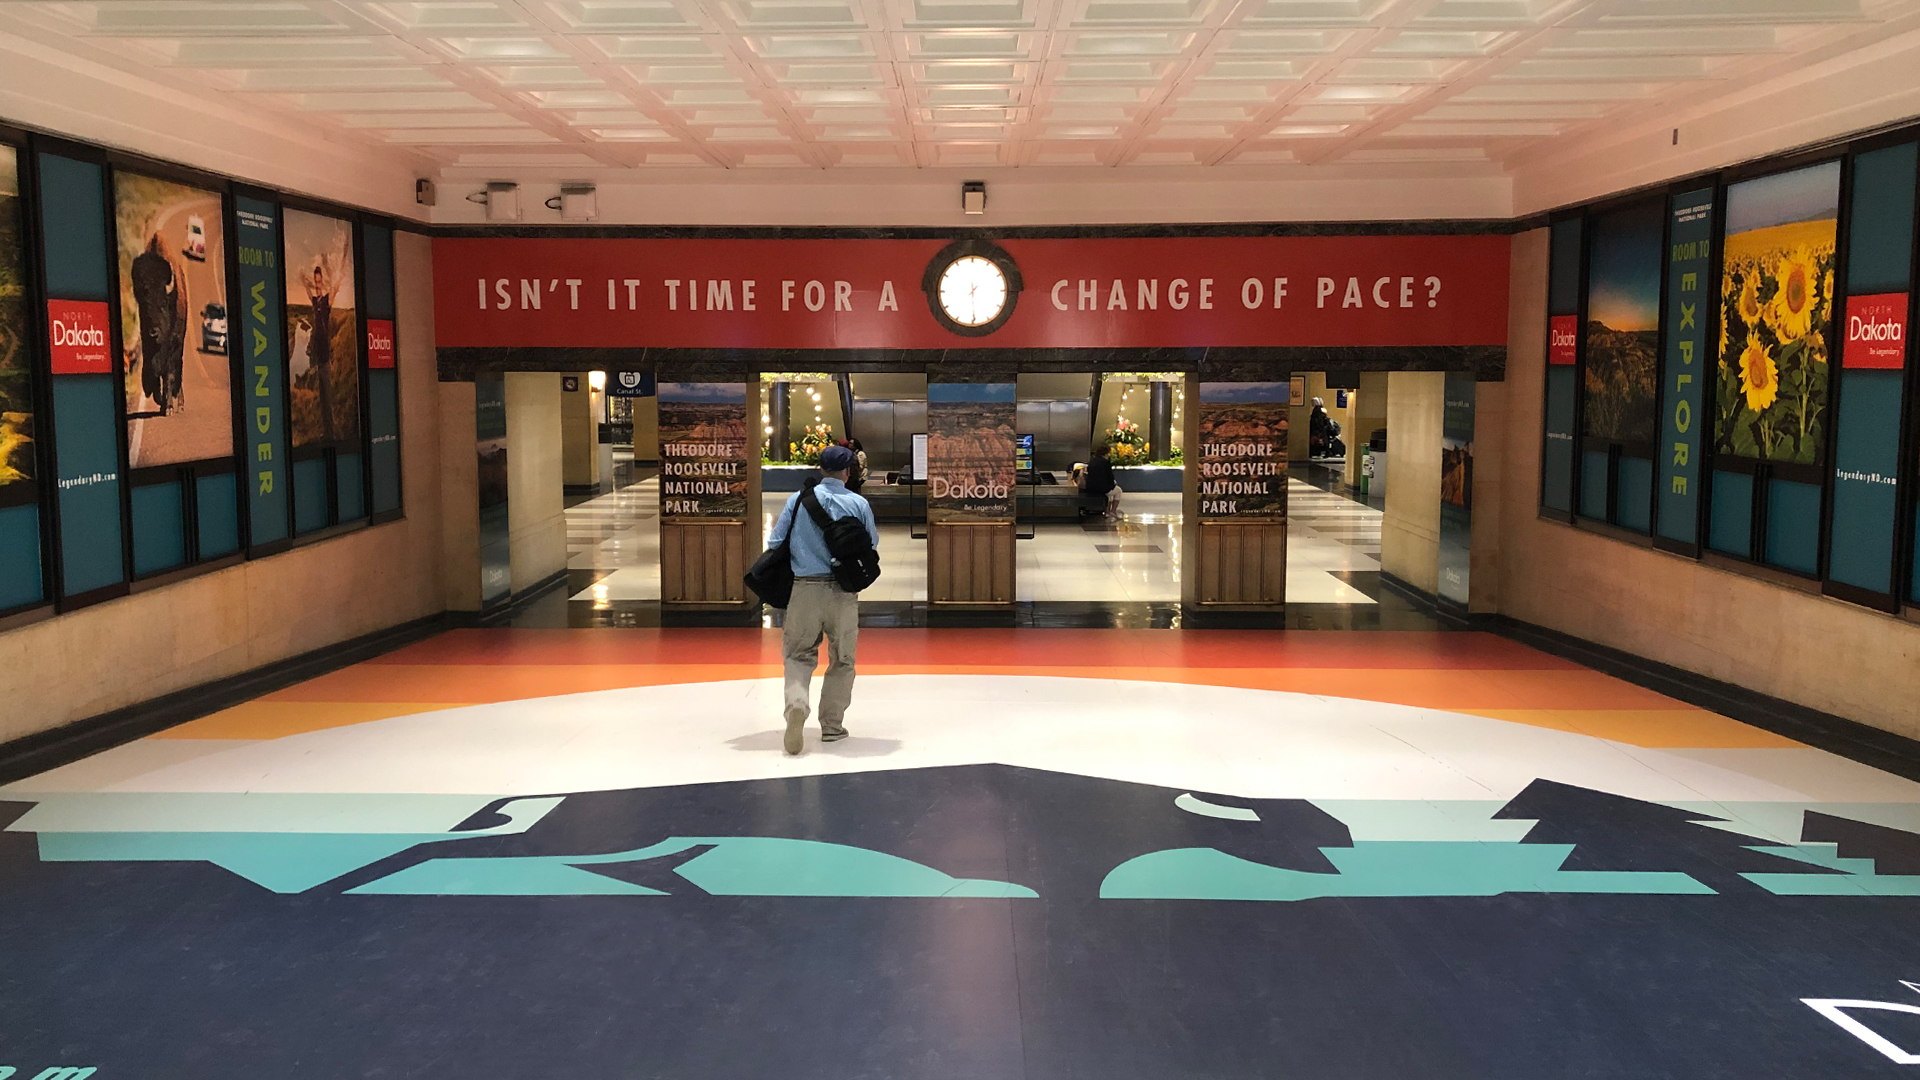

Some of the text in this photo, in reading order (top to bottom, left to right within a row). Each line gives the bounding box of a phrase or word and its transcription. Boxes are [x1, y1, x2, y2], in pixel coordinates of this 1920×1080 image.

[239, 246, 275, 268] ROOM TO
[1673, 239, 1710, 261] ROOM TO
[607, 278, 640, 311] IT
[664, 279, 756, 311] TIME
[781, 279, 853, 312] FOR
[877, 280, 899, 312] A
[1050, 278, 1213, 311] CHANGE
[1241, 277, 1288, 310] OF
[1316, 275, 1442, 309] PACE?
[53, 319, 104, 347] Dakota
[1850, 315, 1902, 341] Dakota
[368, 332, 391, 350] Dakota
[1552, 329, 1575, 347] Dakota
[251, 280, 274, 497] WANDER
[1671, 272, 1697, 496] EXPLORE
[664, 443, 733, 457] THEODORE
[1203, 443, 1273, 457] THEODORE
[664, 462, 738, 476] ROOSEVELT
[1202, 462, 1277, 476] ROOSEVELT
[665, 481, 731, 495] NATIONAL
[932, 477, 1008, 499] Dakota
[1202, 481, 1269, 495] NATIONAL
[665, 500, 700, 514] PARK
[963, 503, 1008, 513] Be Legendary
[1202, 500, 1237, 514] PARK
